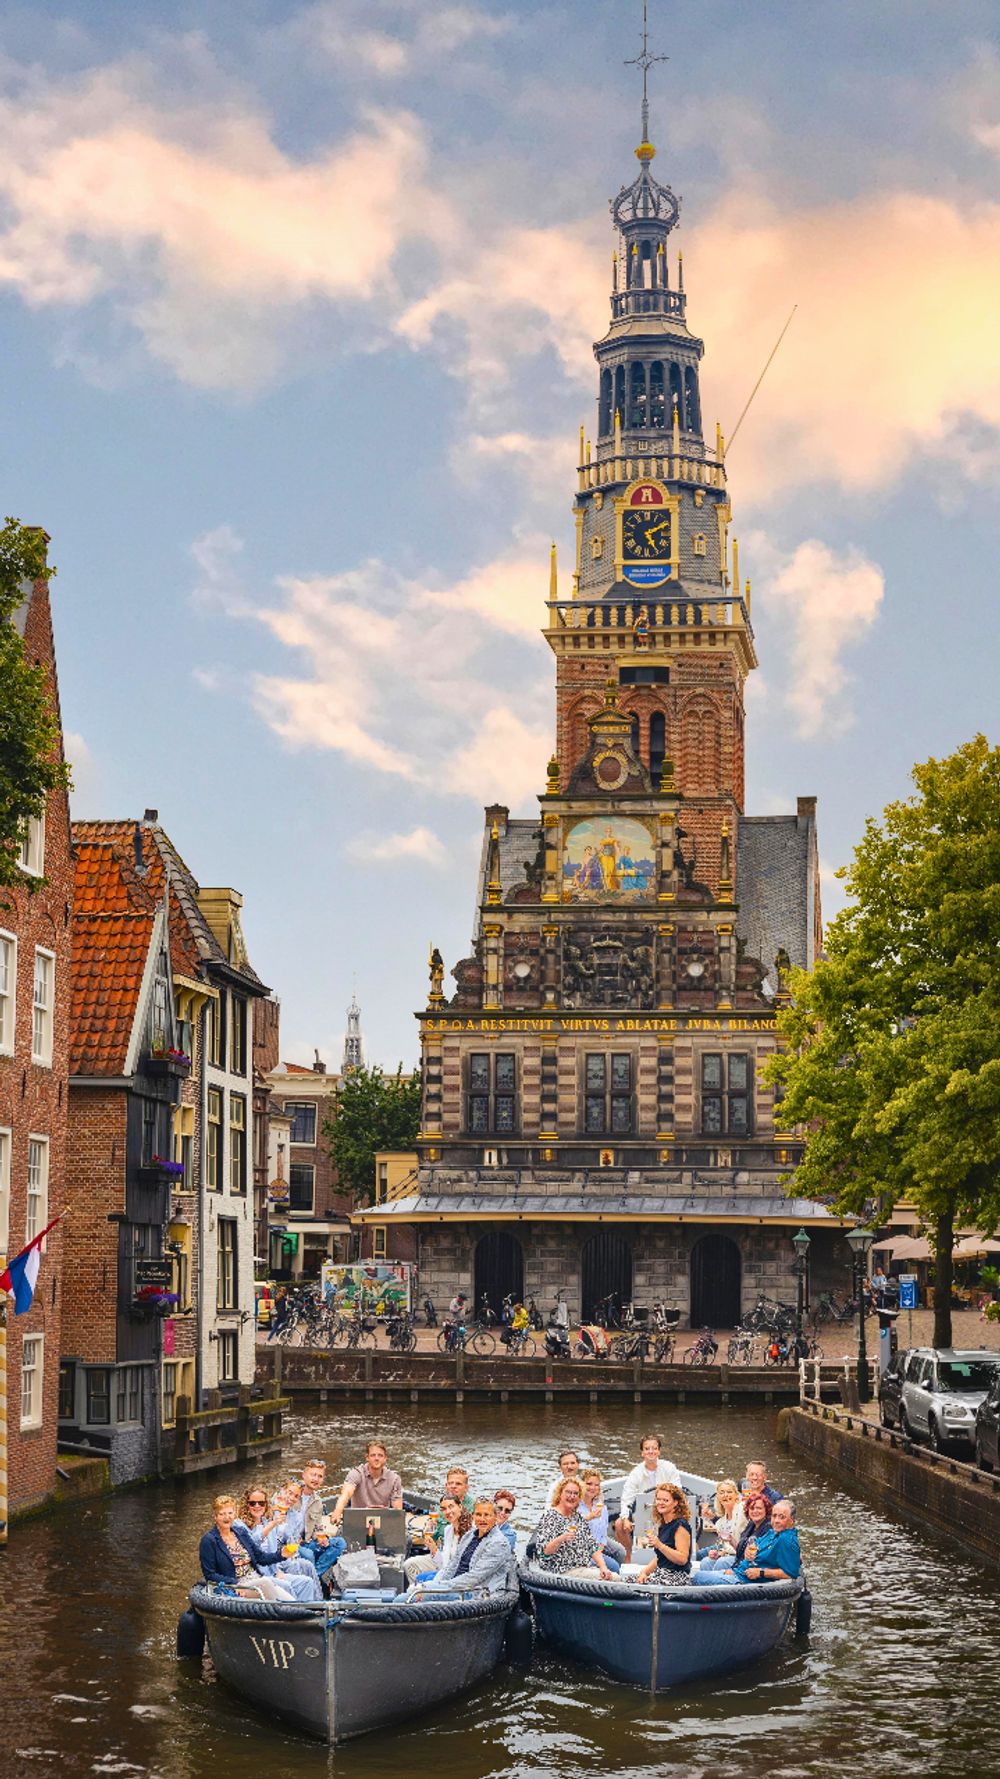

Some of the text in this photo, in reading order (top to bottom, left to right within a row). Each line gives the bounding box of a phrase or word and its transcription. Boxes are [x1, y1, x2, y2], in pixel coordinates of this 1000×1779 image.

[481, 1019, 554, 1031] RESTITVIT
[560, 1019, 609, 1031] VIRTVS
[616, 1019, 678, 1031] ABLATAE
[249, 1635, 295, 1669] VIP
